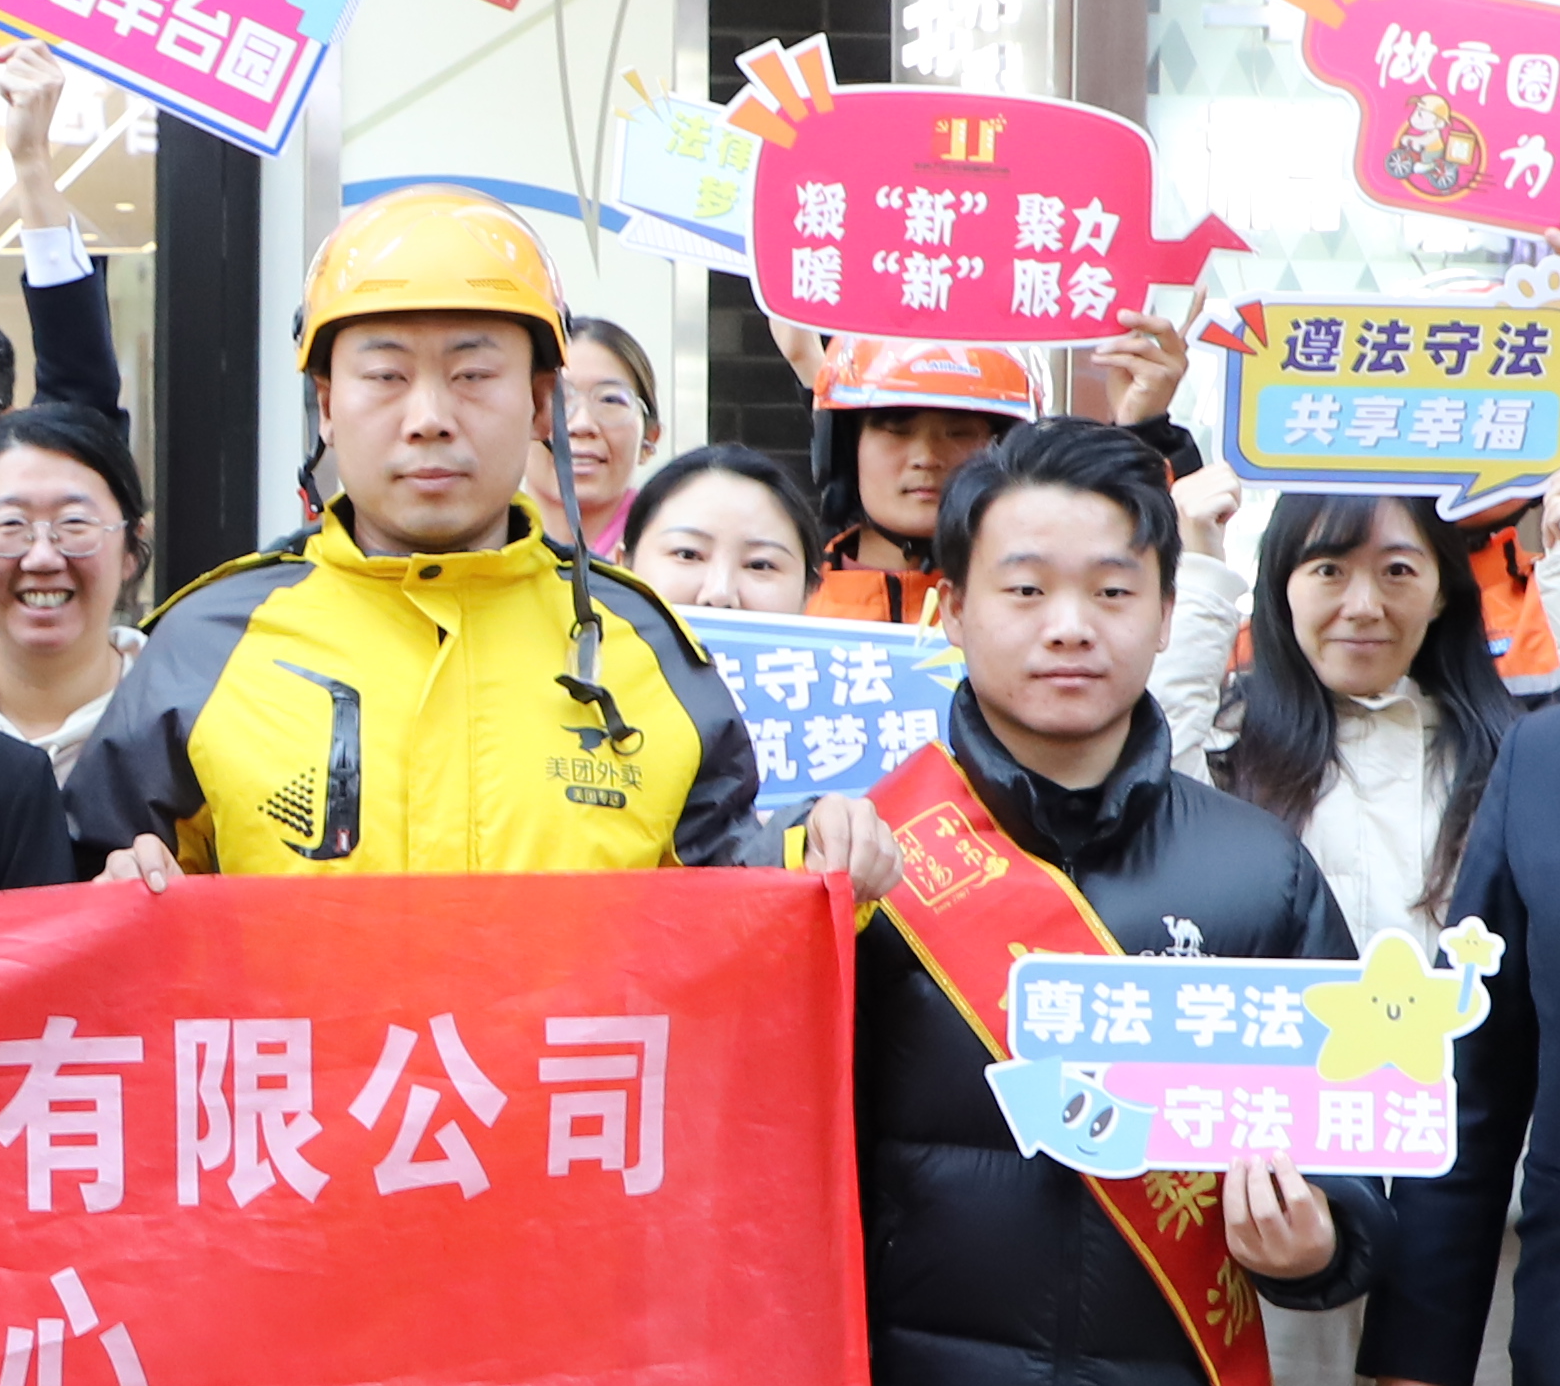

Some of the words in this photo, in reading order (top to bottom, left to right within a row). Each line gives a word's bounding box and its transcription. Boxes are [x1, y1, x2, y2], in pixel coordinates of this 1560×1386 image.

[794, 180, 846, 241] 凝
[1015, 193, 1120, 257] 聚力
[791, 245, 842, 306] 暖
[1011, 259, 1117, 321] 服务
[1280, 318, 1553, 378] 遵法守法
[1284, 392, 1535, 452] 共享幸福
[545, 756, 643, 792] 美团外卖
[1023, 979, 1154, 1046] 尊法
[1175, 984, 1304, 1049] 学法
[1163, 1085, 1293, 1151] 守法
[1316, 1090, 1447, 1155] 用法
